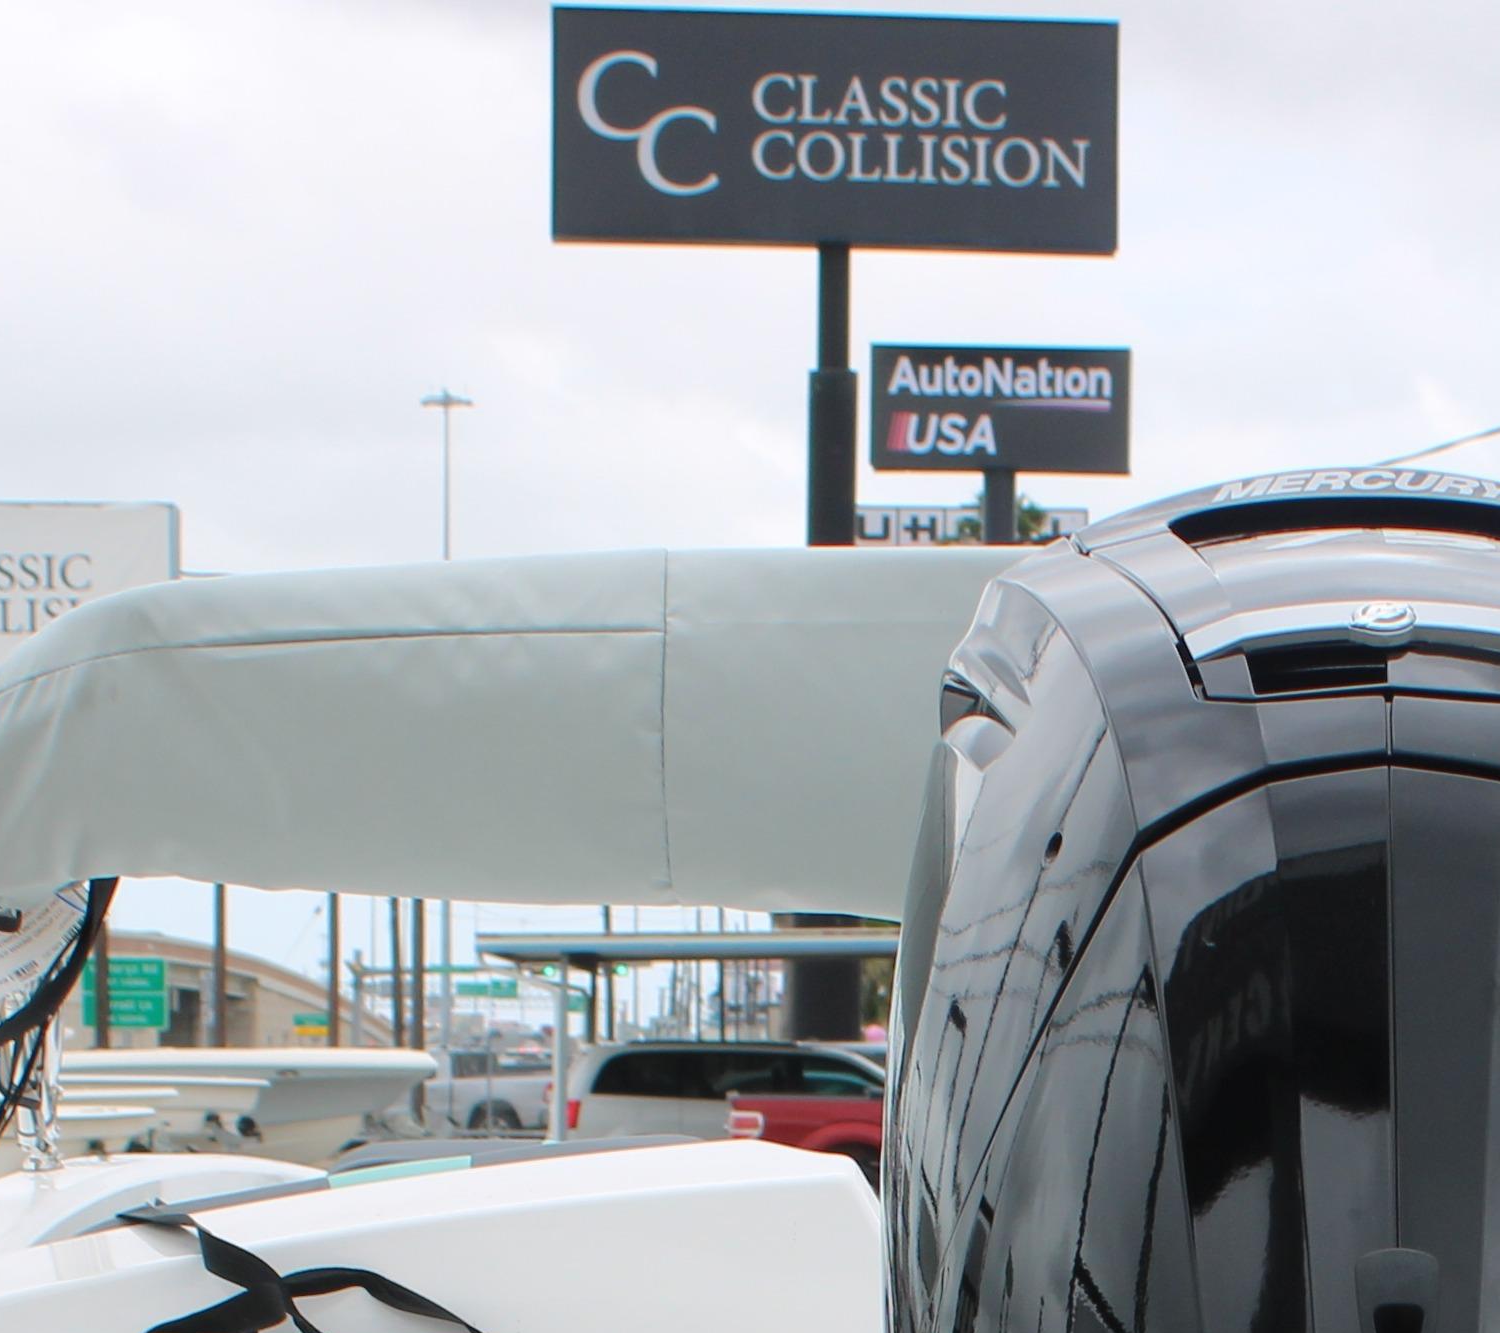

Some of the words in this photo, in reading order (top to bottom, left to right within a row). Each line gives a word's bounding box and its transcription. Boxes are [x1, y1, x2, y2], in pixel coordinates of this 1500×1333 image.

[577, 50, 719, 196] CC
[751, 73, 1007, 130] CLASSIC
[751, 131, 1090, 189] COLLISION
[888, 356, 1112, 398] AutoNation
[905, 413, 997, 455] USA
